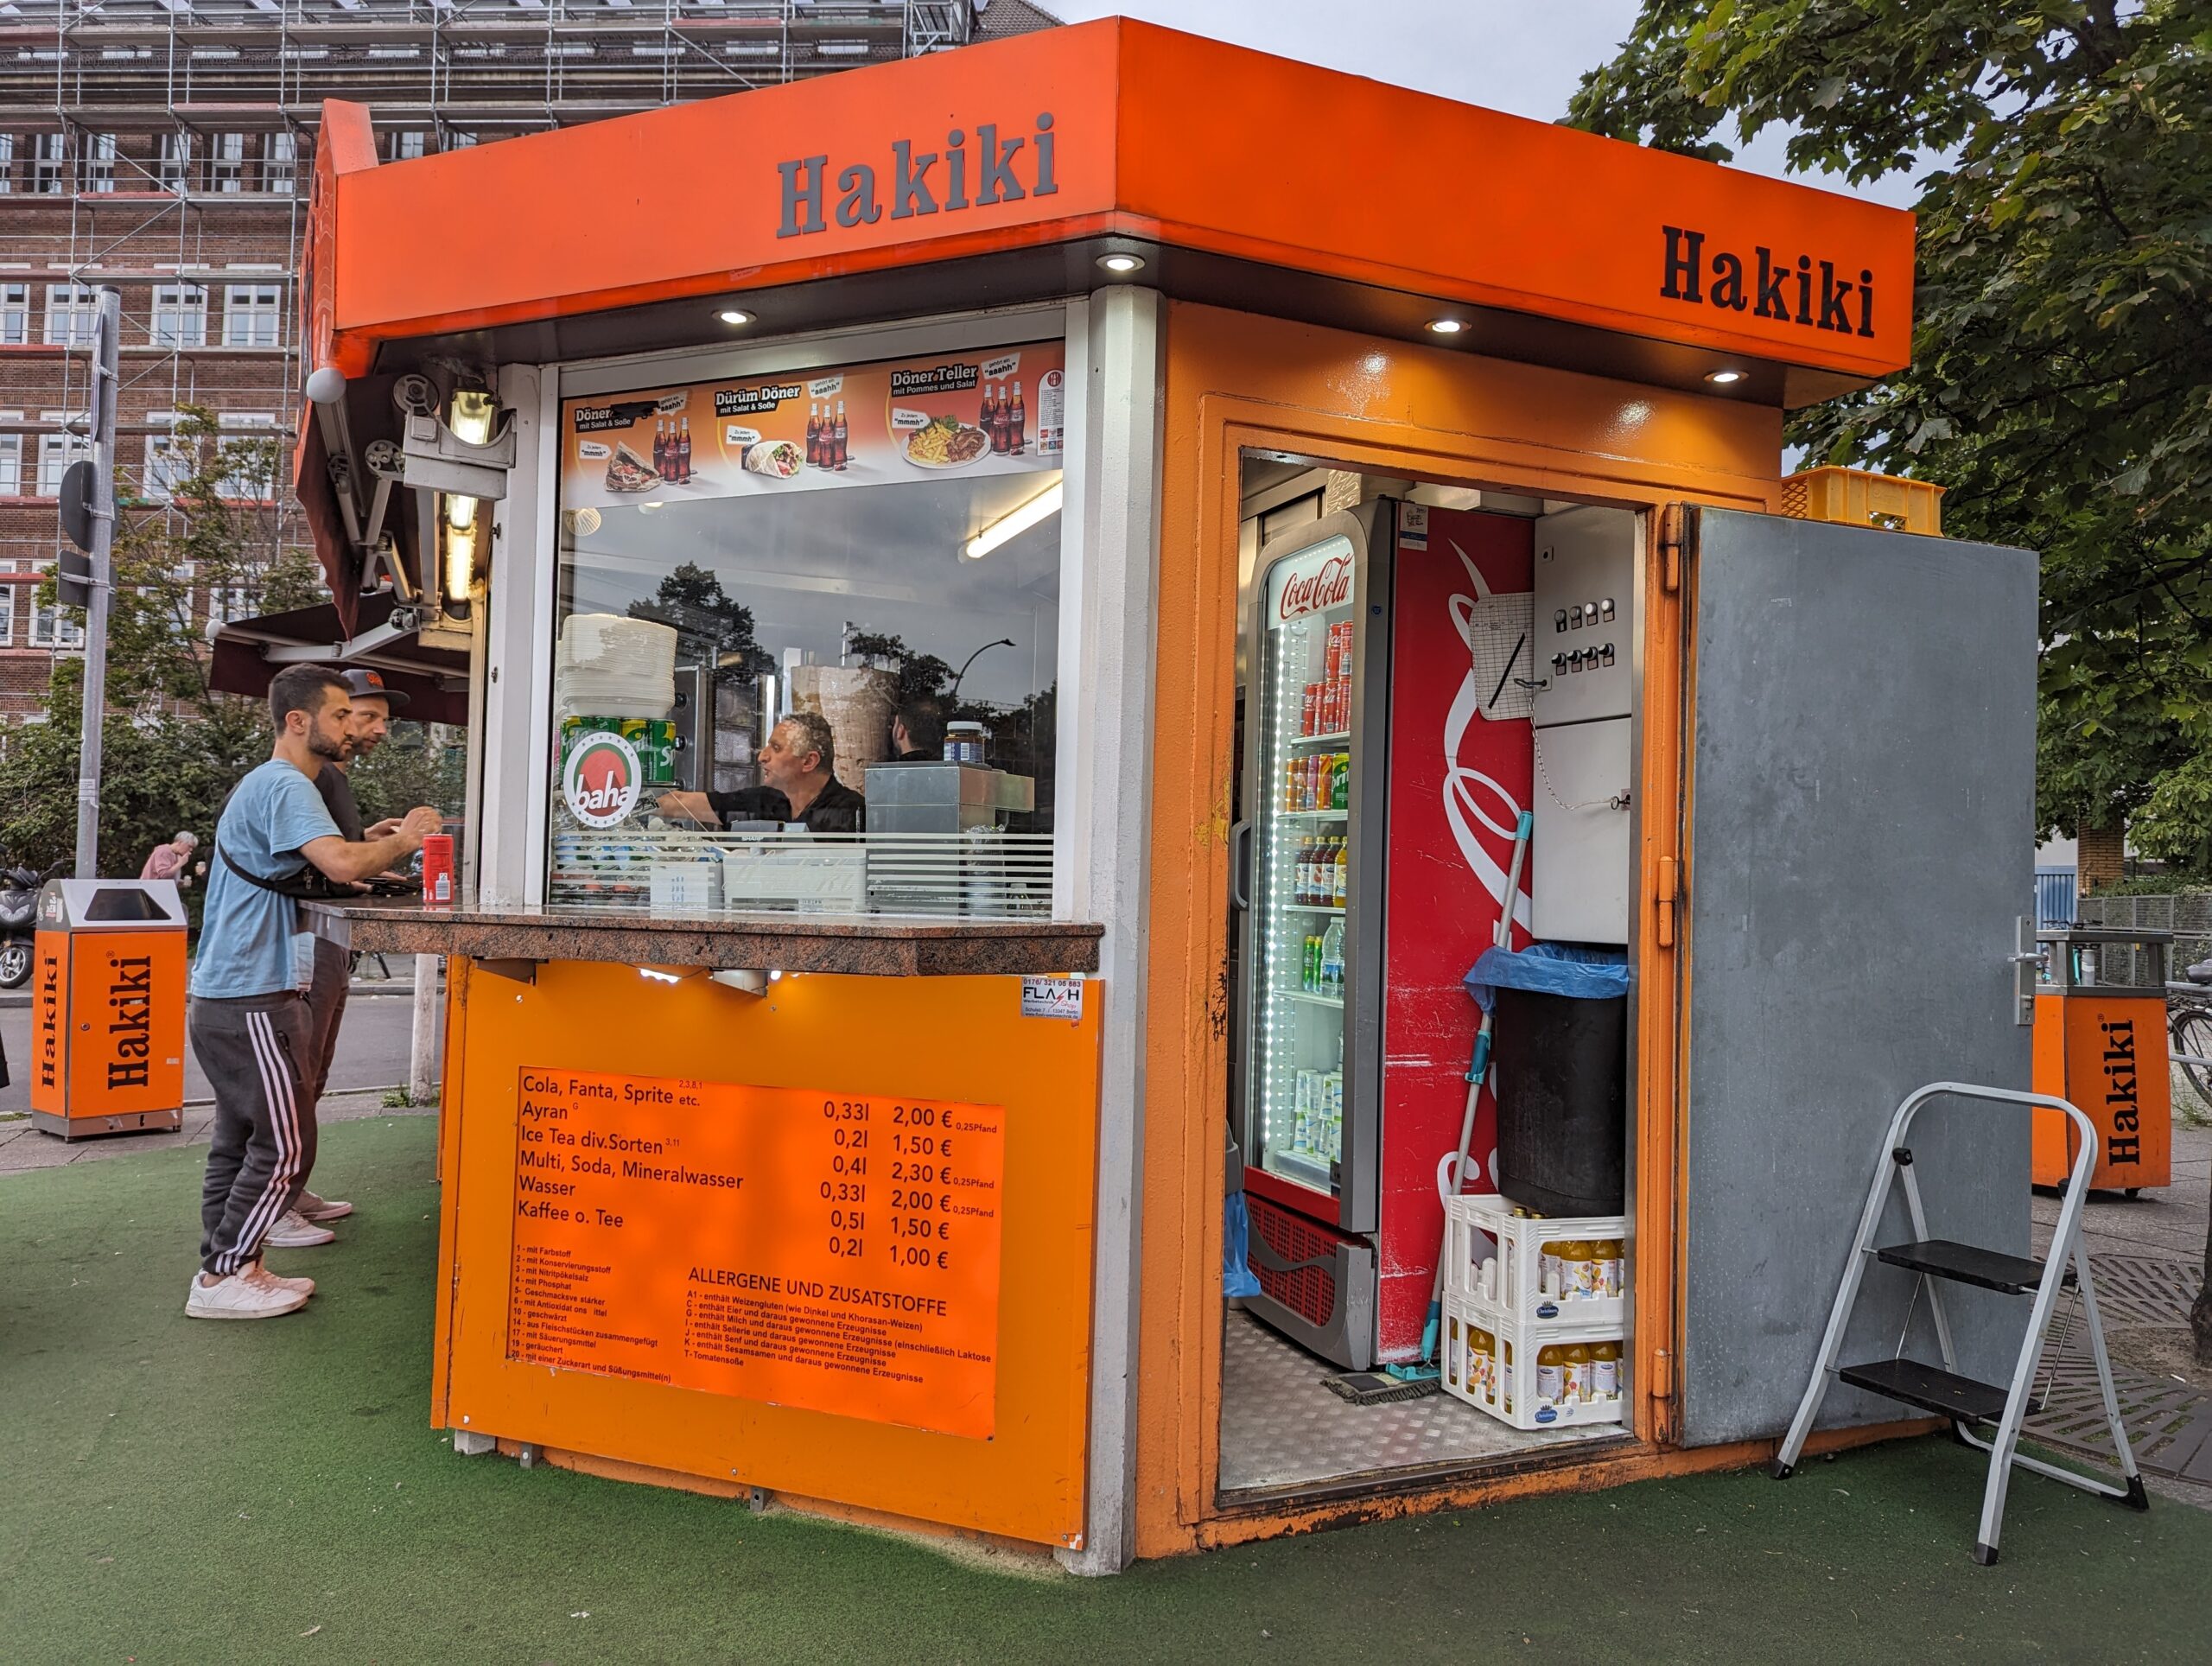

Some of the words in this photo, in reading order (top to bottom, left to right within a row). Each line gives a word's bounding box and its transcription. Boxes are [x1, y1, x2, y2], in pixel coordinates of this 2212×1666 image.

[776, 111, 1058, 238] Hakiki
[1660, 225, 1875, 338] Hakiki
[938, 366, 977, 380] Teller
[716, 391, 758, 405] Dürüm
[761, 385, 801, 400] Döner
[907, 385, 938, 394] Pommes
[576, 408, 611, 422] Döner
[733, 404, 749, 413] Salat
[575, 771, 632, 810] baha
[42, 956, 58, 1090] Hakiki
[108, 956, 151, 1090] Hakiki
[524, 1076, 563, 1097] Cola,
[569, 1079, 618, 1102] Fanta,
[624, 1084, 674, 1104] Sprite
[679, 1096, 700, 1106] etc.
[893, 1106, 935, 1128] 2,00
[941, 1110, 953, 1129] €
[956, 1122, 997, 1134] 0,25Pfand
[2101, 1019, 2139, 1166] Hakiki
[522, 1101, 568, 1121] Ayran
[893, 1135, 934, 1155] 1,50
[940, 1139, 952, 1157] €
[522, 1125, 543, 1142] Ice
[549, 1128, 575, 1146] Tea
[892, 1161, 933, 1183] 2,30
[940, 1167, 951, 1186] €
[953, 1177, 995, 1189] 0,25Pfand
[521, 1150, 565, 1173] Multi,
[571, 1155, 616, 1179] Soda,
[623, 1160, 744, 1190] Mineralwasser
[892, 1189, 933, 1211] 2,00
[940, 1195, 951, 1213] €
[953, 1205, 995, 1218] 0,25Pfand
[519, 1175, 576, 1196] Wasser
[891, 1217, 931, 1238] 1,50
[938, 1222, 950, 1241] €
[518, 1200, 569, 1221] Kaffee
[575, 1211, 589, 1224] o.
[595, 1209, 624, 1228] Tee
[890, 1245, 931, 1267] 1,00
[937, 1251, 949, 1269] €
[526, 1267, 537, 1275] mit
[524, 1299, 536, 1307] mit
[689, 1267, 781, 1294] ALLERGENE
[787, 1280, 824, 1299] UND
[829, 1285, 947, 1317] ZUSATSTOFFE
[699, 1303, 725, 1313] enthält
[744, 1309, 760, 1318] und
[704, 1294, 730, 1304] enthält
[831, 1312, 847, 1320] und
[695, 1321, 721, 1332] enthält
[699, 1313, 725, 1322] enthält
[749, 1319, 765, 1328] und
[696, 1332, 722, 1342] enthält
[744, 1339, 759, 1347] und
[696, 1341, 723, 1351] enthält
[525, 1352, 537, 1362] mit
